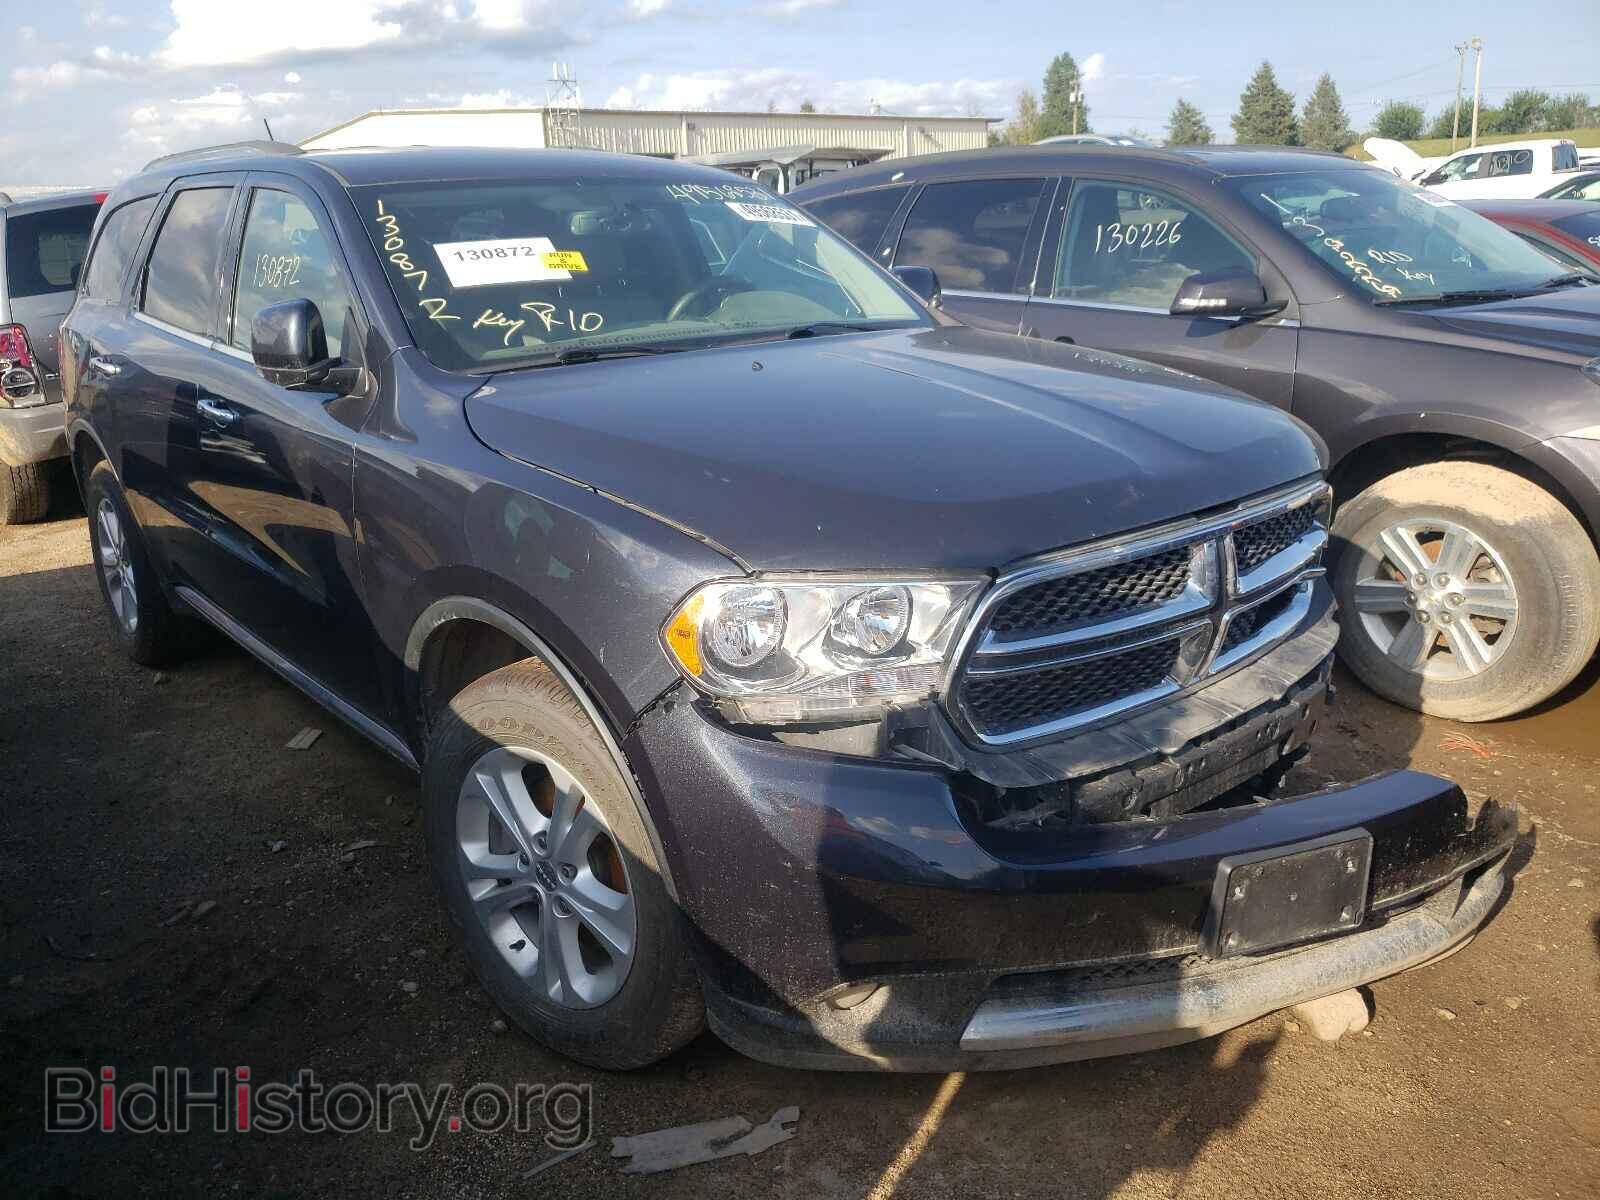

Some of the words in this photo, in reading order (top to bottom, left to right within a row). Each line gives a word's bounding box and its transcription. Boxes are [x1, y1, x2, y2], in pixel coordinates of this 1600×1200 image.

[1095, 220, 1182, 254] 130226
[252, 254, 301, 288] 130872
[453, 246, 536, 263] 130872
[473, 308, 526, 346] Key
